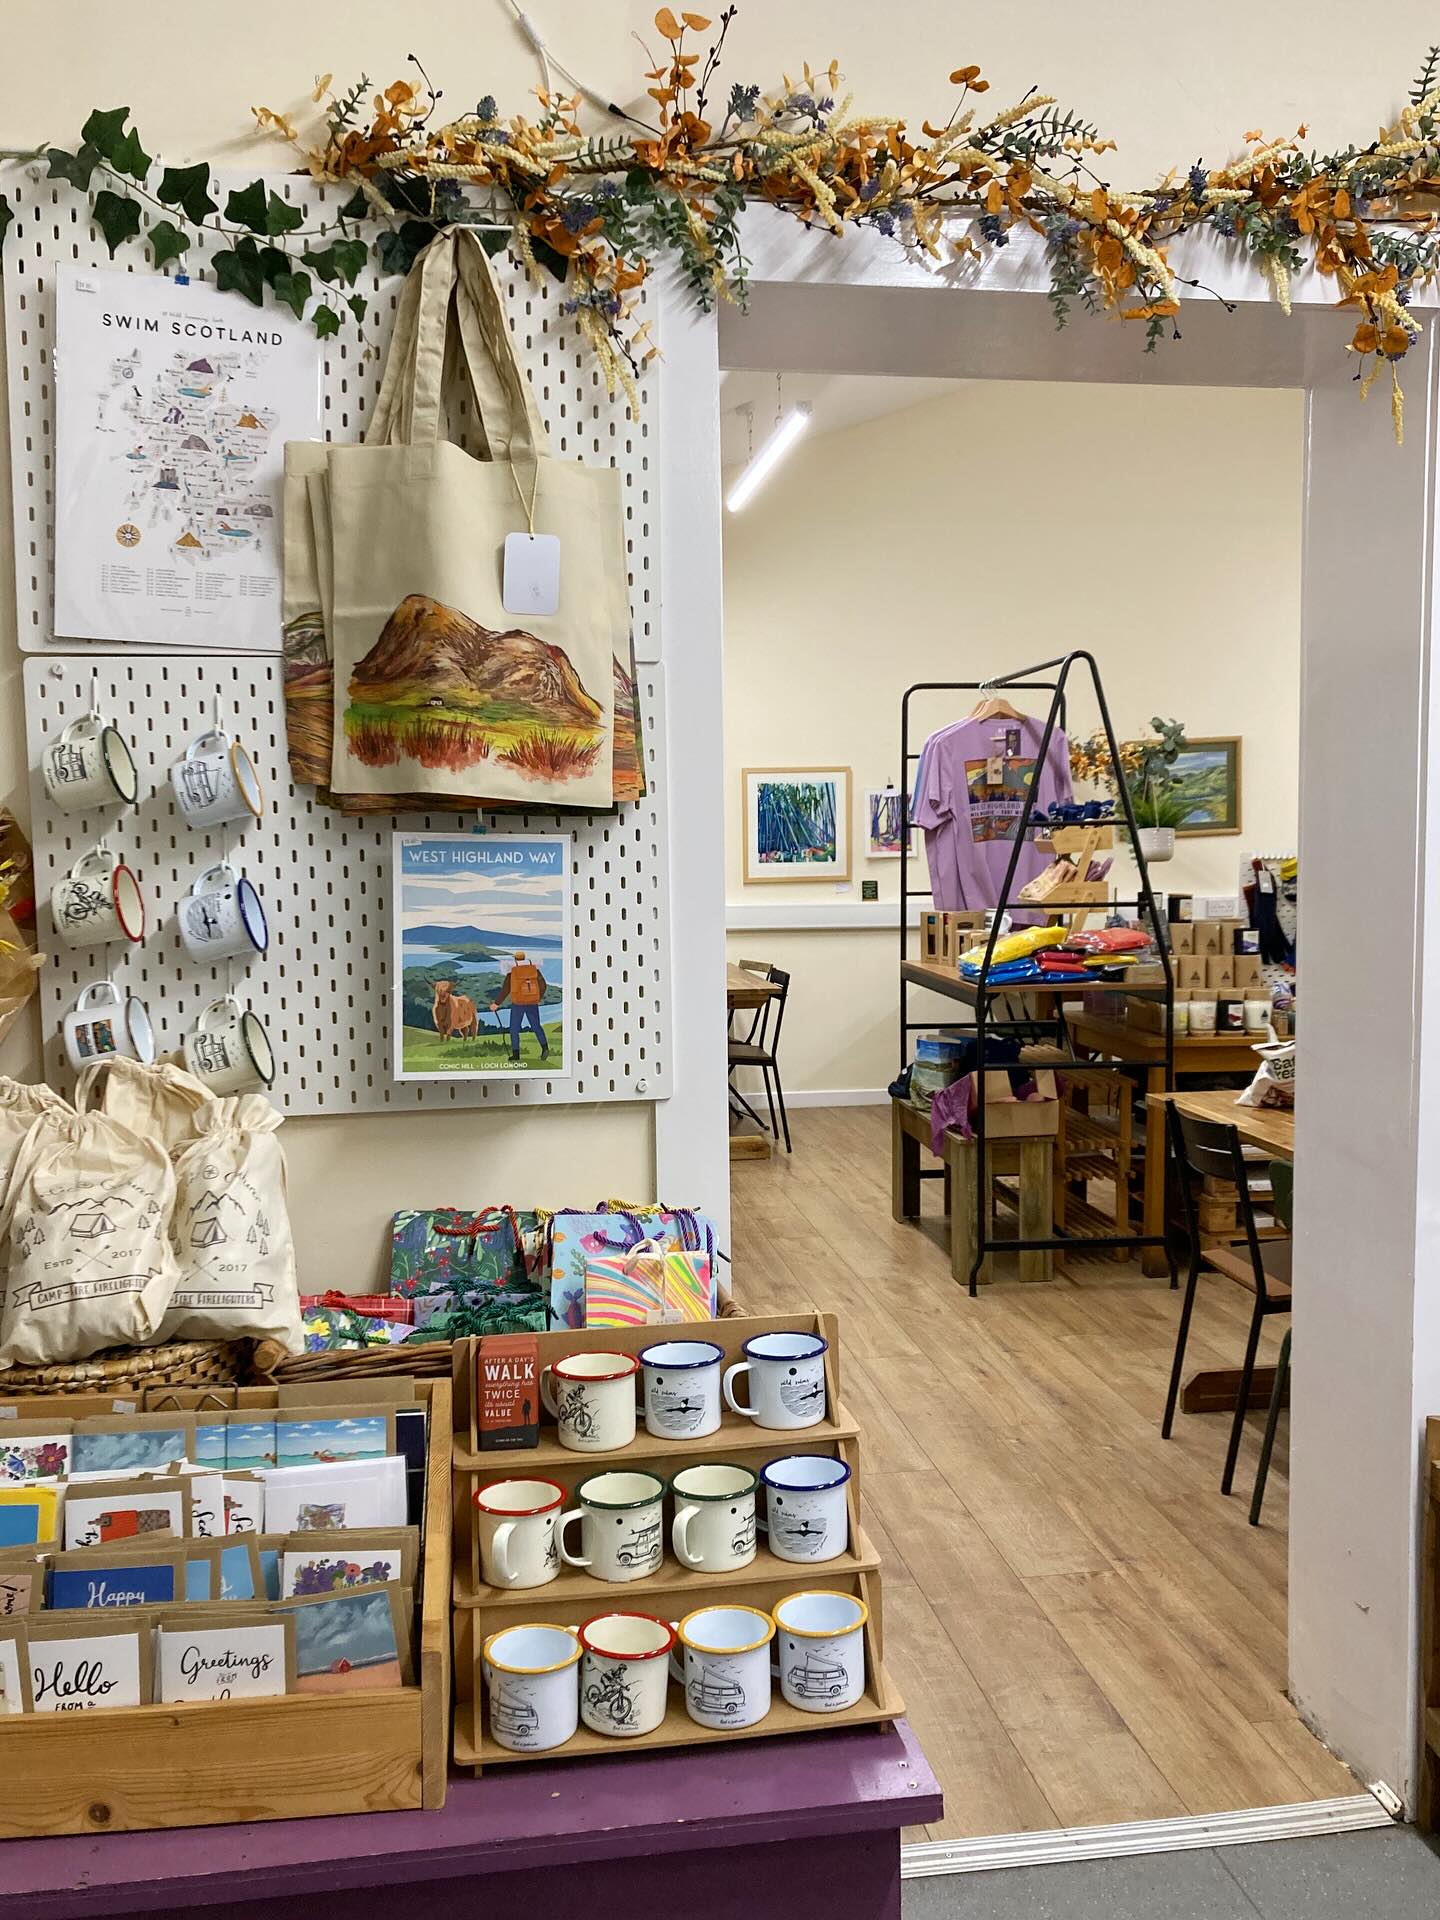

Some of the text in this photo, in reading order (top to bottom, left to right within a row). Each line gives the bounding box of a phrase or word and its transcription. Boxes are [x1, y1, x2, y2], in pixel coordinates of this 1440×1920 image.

[101, 313, 159, 332] SWIM
[171, 322, 283, 346] SCOTLAND
[409, 850, 556, 864] WEST HIGHLAND WAY
[111, 1249, 143, 1259] 2017
[219, 1264, 248, 1272] 2017
[37, 1284, 90, 1304] CAMP-FIRE
[197, 1293, 256, 1305] FIRELIGHTERS
[484, 1363, 535, 1381] WALK
[484, 1389, 521, 1400] TWICE
[484, 1408, 512, 1417] VALUE
[87, 1581, 145, 1608] Happy
[180, 1645, 275, 1685] Greetings
[34, 1660, 119, 1703] Hello
[55, 1701, 83, 1712] FROM
